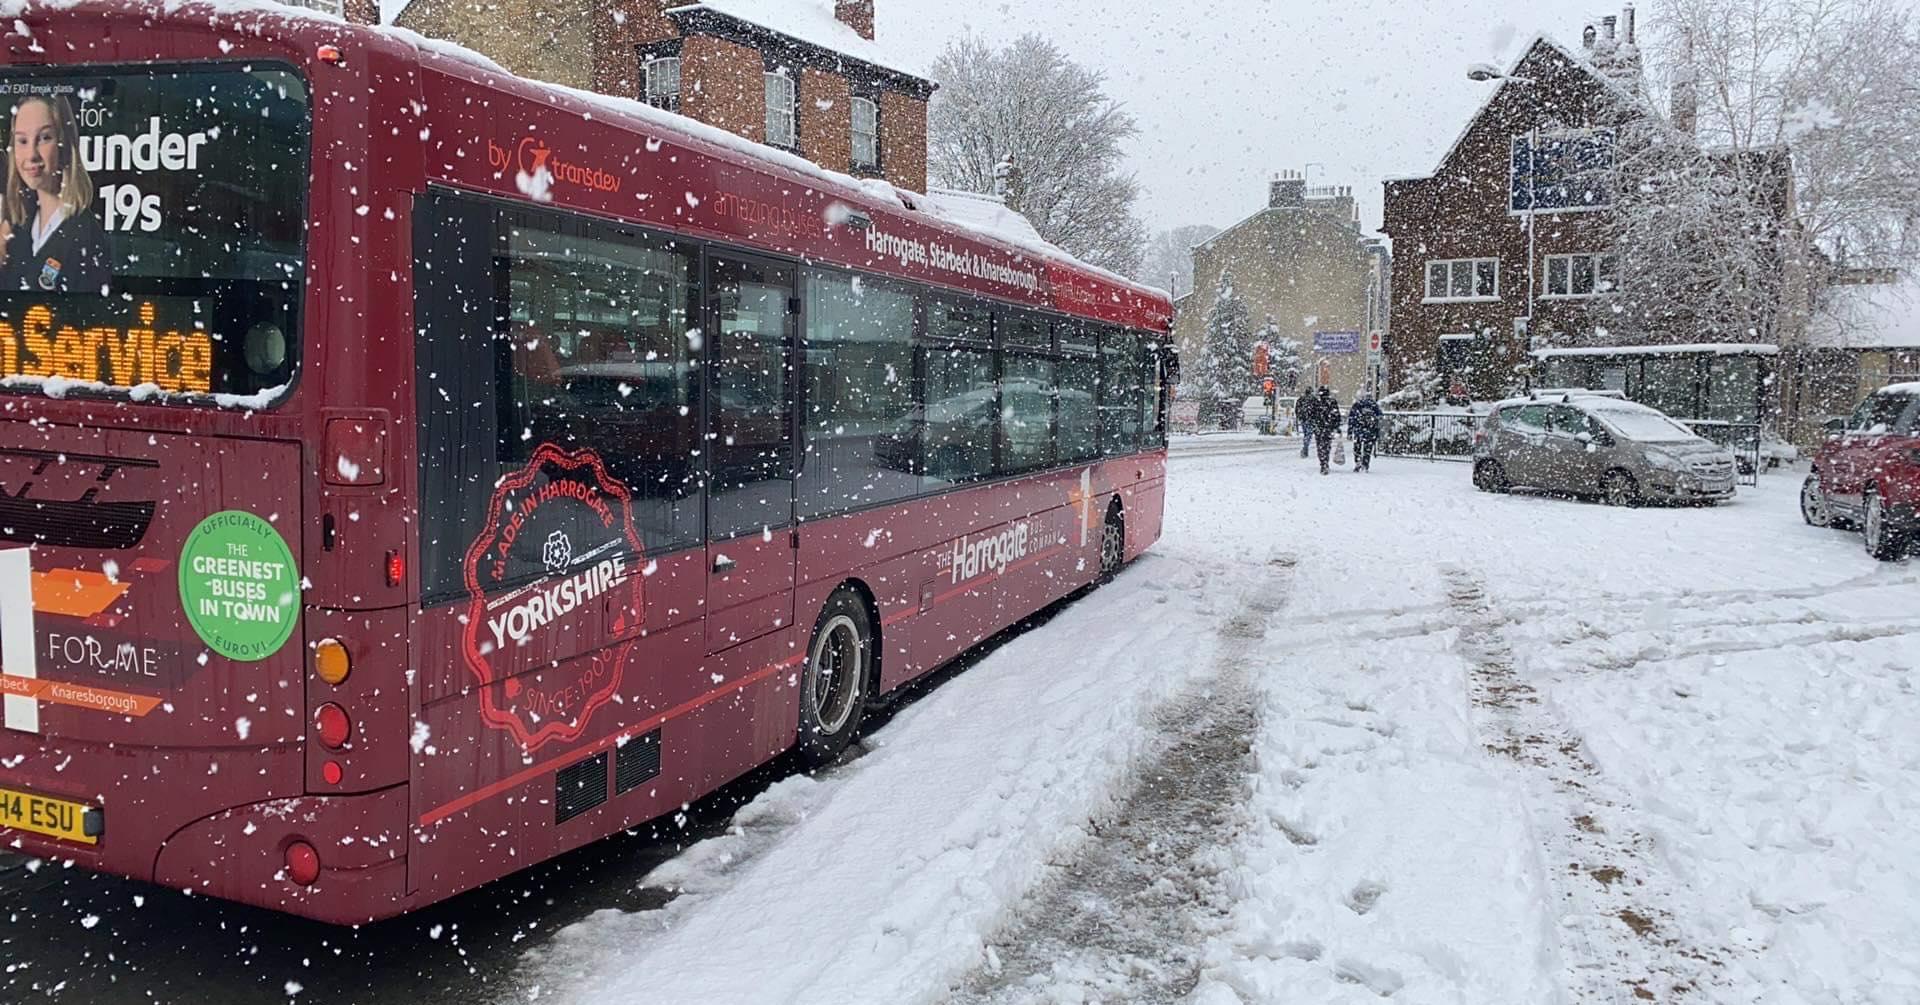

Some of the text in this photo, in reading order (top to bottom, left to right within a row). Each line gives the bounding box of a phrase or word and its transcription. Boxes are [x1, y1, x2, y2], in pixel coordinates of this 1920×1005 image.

[13, 83, 29, 94] EXIT
[31, 84, 52, 94] break
[53, 84, 74, 95] glass
[80, 100, 107, 127] for
[79, 116, 206, 171] under
[488, 140, 622, 193] by transdev
[100, 184, 162, 232] 19s
[714, 190, 780, 236] amazing
[782, 198, 821, 238] buses
[865, 224, 928, 269] Harrogate,
[930, 241, 972, 275] Starbeck
[973, 254, 981, 276] &
[981, 256, 1038, 290] Knaresborough
[23, 302, 211, 394] Service
[202, 514, 272, 539] OFFICIALLY
[491, 479, 614, 581] MADE IN HARROGATE
[226, 543, 248, 557] THE
[937, 522, 1028, 584] THE Harrogate
[193, 556, 284, 581] GREENEST
[211, 578, 266, 601] BUSES
[488, 551, 627, 650] YORKSHIRE
[200, 598, 280, 624] IN TOWN
[49, 633, 158, 677] FOR ME
[214, 636, 267, 656] EURO VI
[51, 684, 138, 712] Knaresborough
[523, 685, 574, 716] SINCE
[30, 799, 73, 832] ESU
